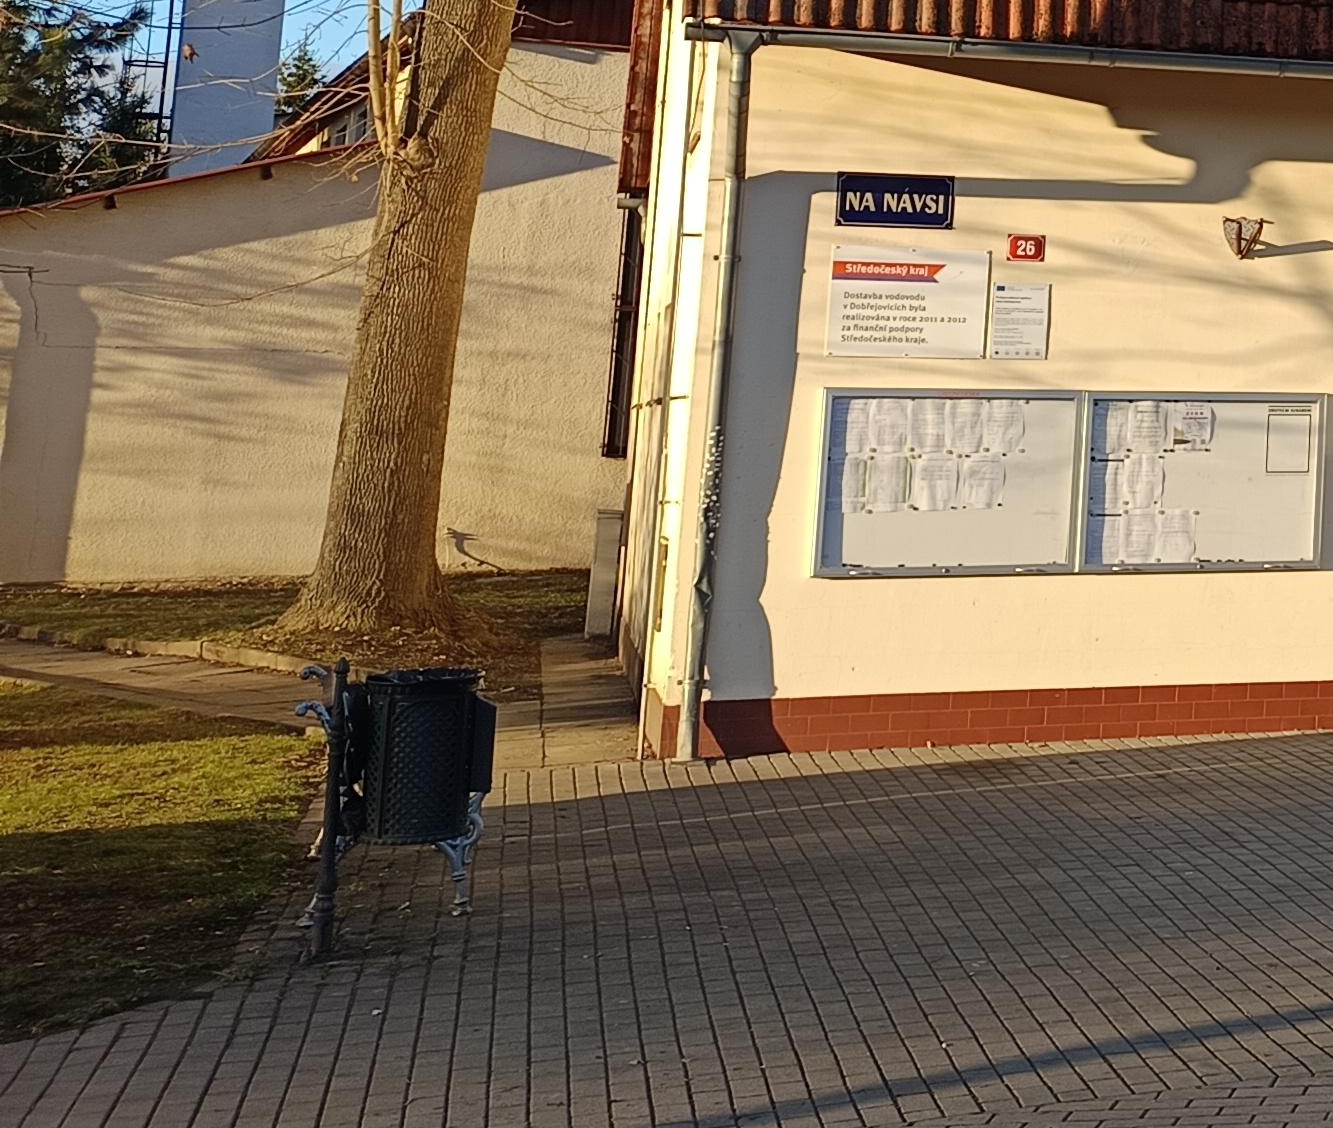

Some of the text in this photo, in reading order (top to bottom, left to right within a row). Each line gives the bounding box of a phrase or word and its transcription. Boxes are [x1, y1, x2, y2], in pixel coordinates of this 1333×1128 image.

[845, 187, 945, 215] NA NÁVSI
[1016, 239, 1036, 256] 26
[845, 263, 929, 277] Středočeský kraj
[843, 291, 926, 301] Dostavba vodovodu
[909, 304, 927, 312] byla
[842, 313, 890, 321] realizována
[853, 323, 888, 332] finanční
[888, 325, 924, 333] podpory
[841, 334, 903, 343] Středočeského
